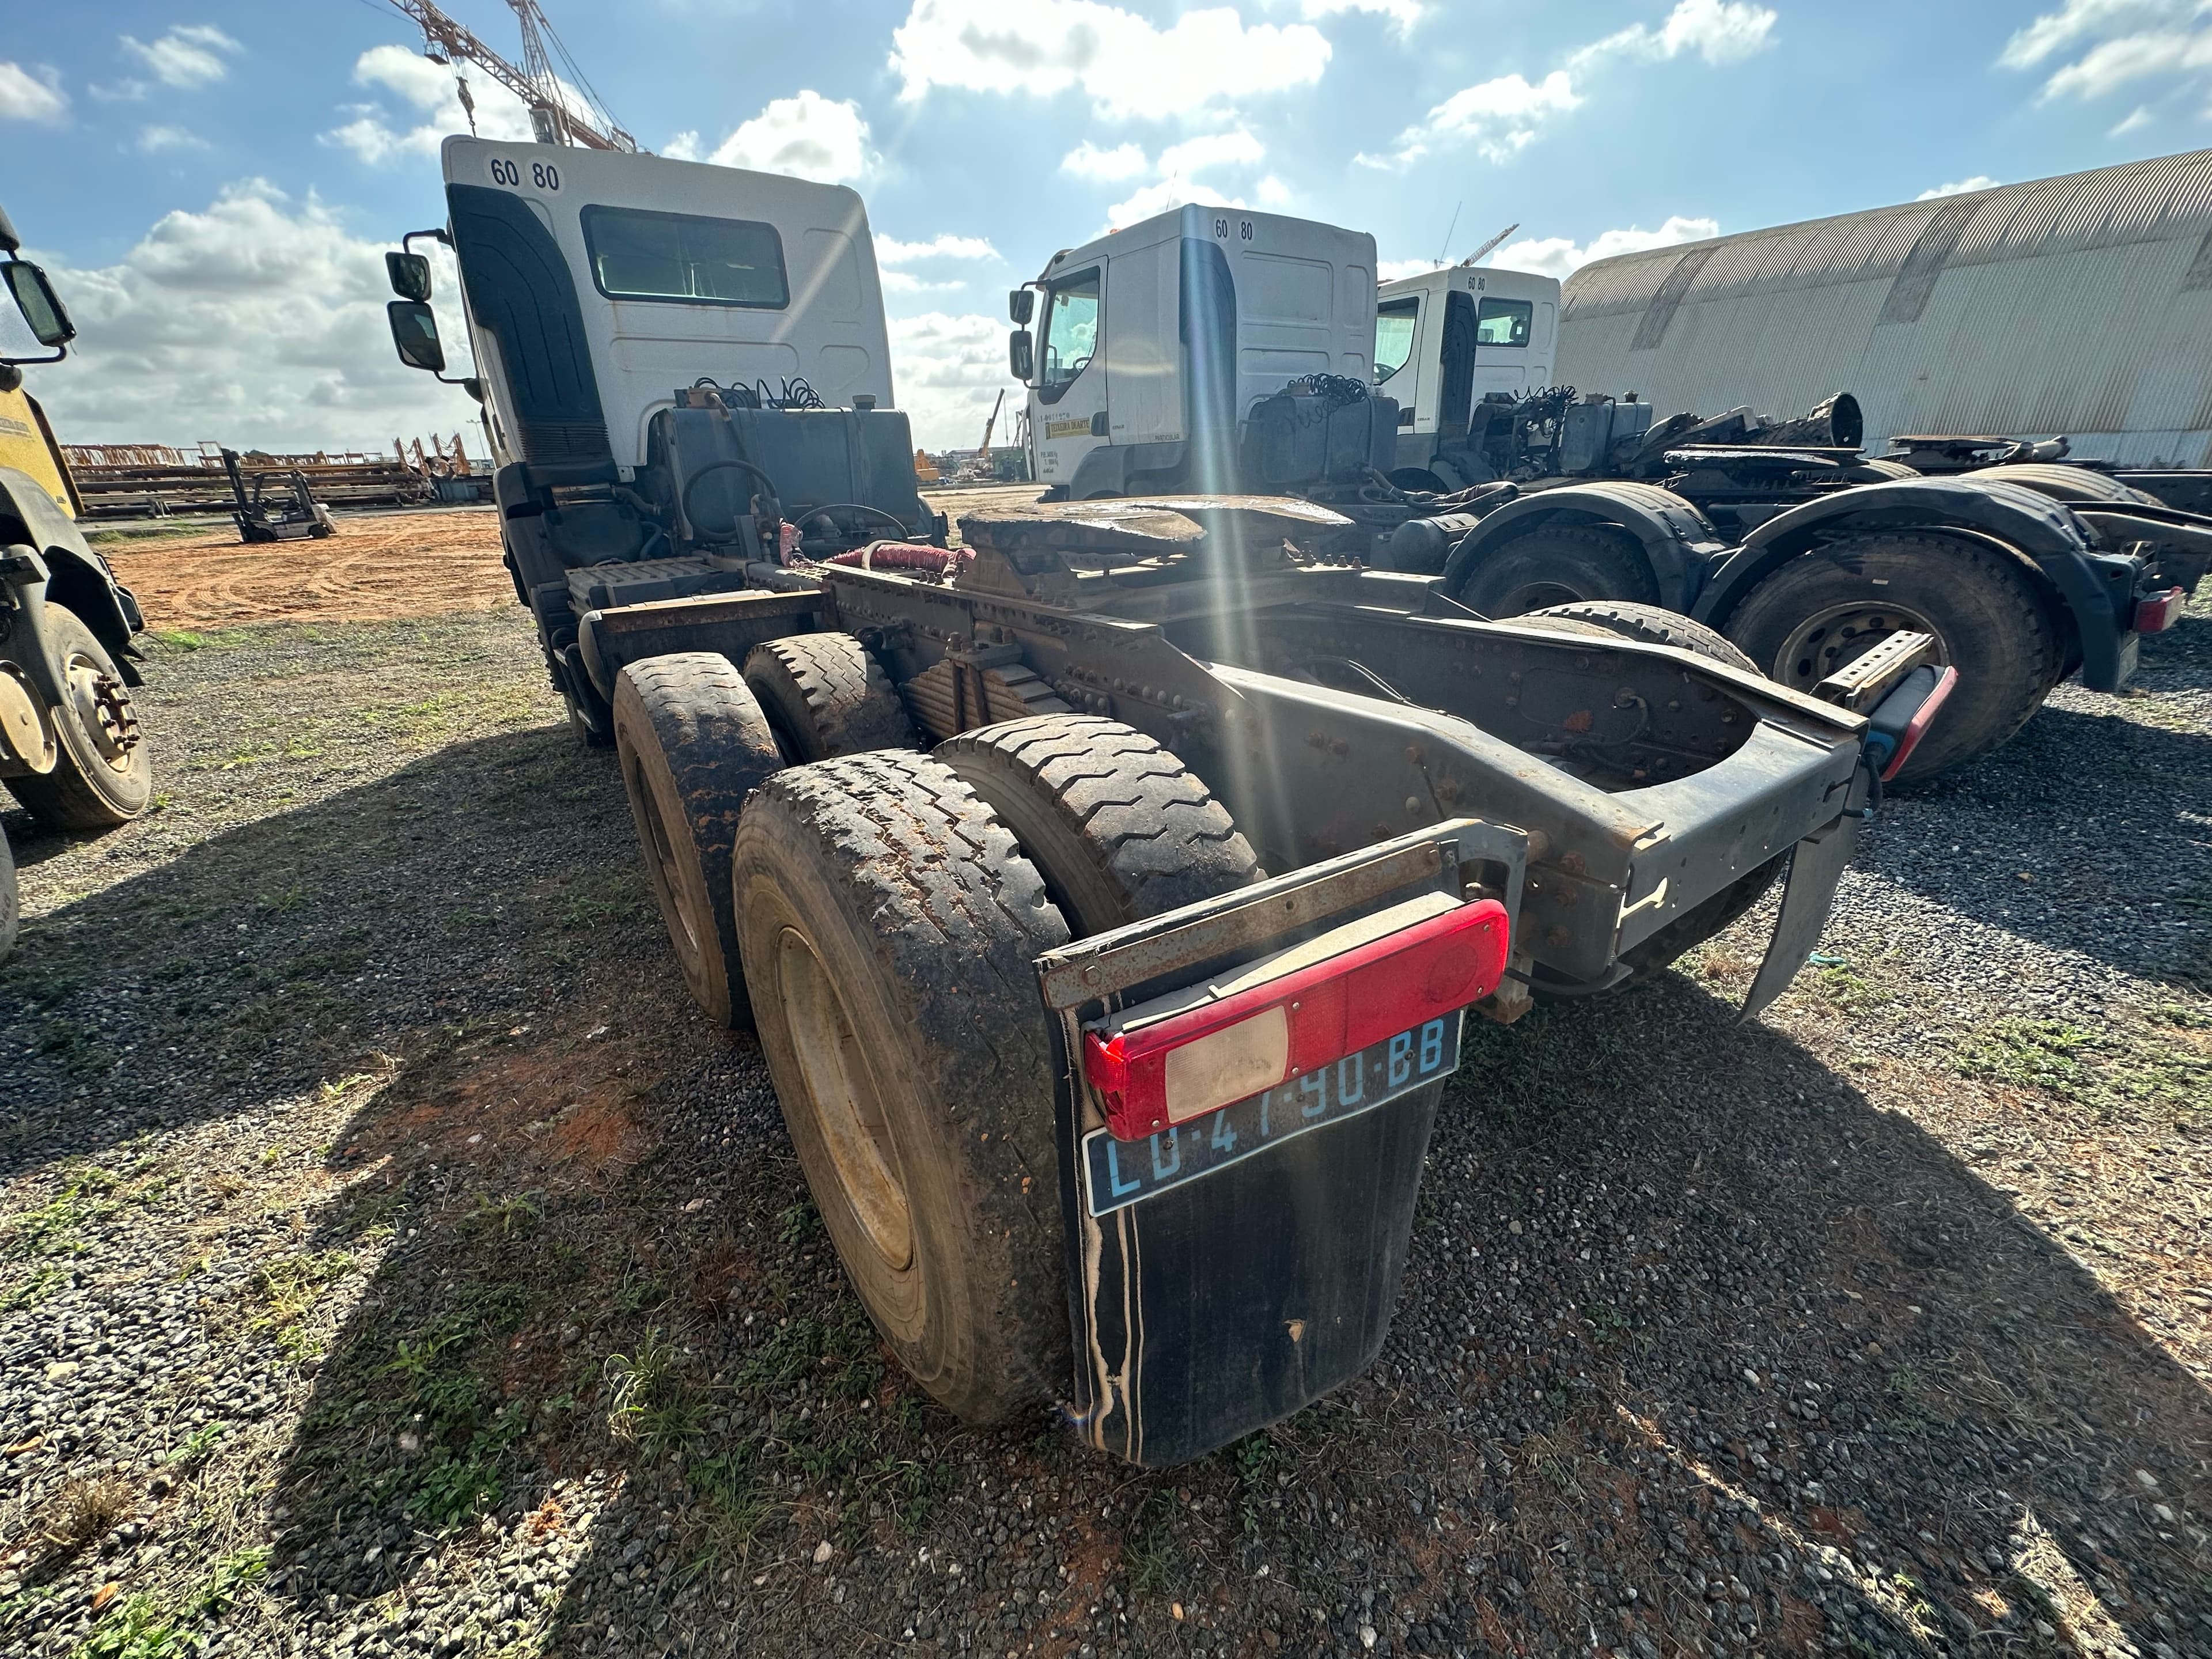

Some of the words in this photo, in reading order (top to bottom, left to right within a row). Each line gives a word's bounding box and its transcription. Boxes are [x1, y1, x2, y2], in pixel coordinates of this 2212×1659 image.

[491, 158, 519, 186] 60
[532, 162, 559, 191] 80
[1215, 219, 1228, 238] 60
[1241, 221, 1252, 240] 80
[1468, 276, 1475, 290] 60
[1478, 277, 1485, 291] 80
[1071, 419, 1089, 430] DUARTE
